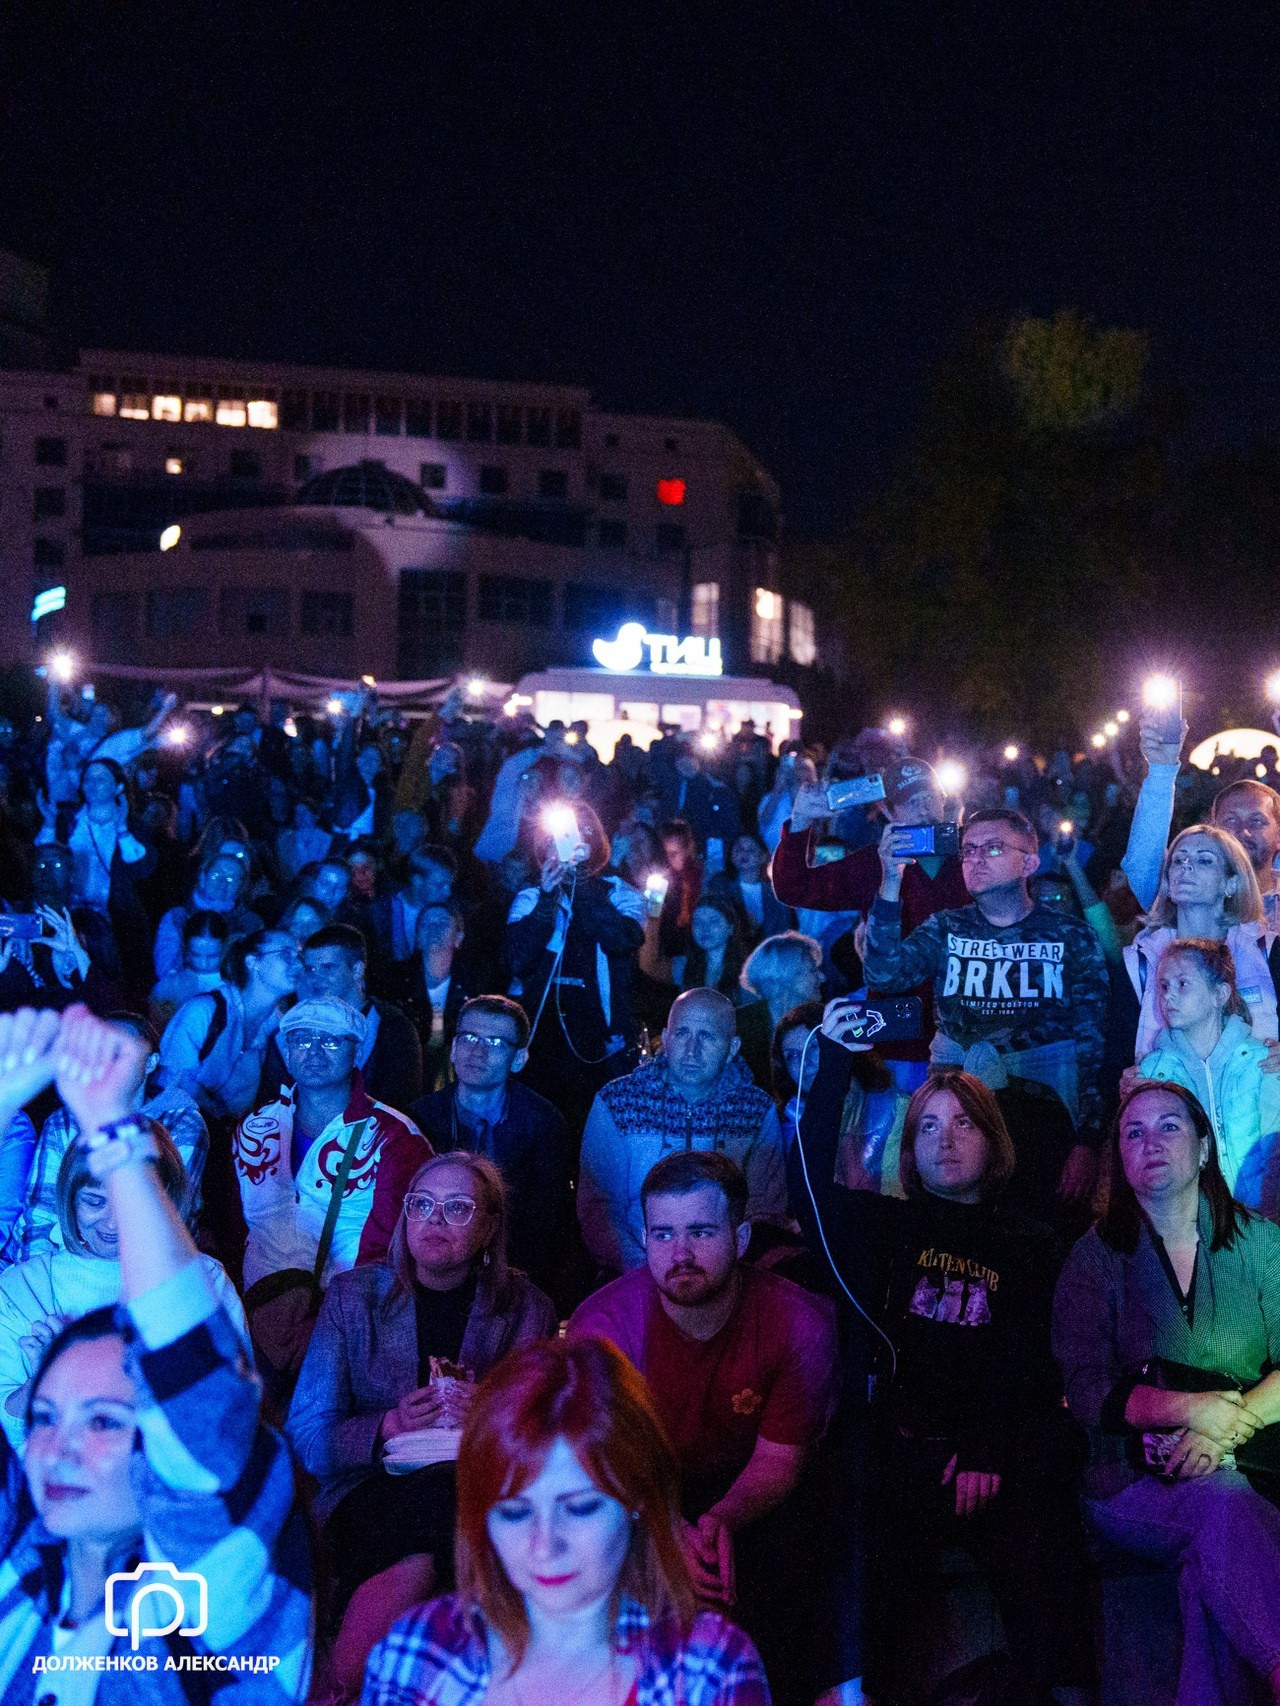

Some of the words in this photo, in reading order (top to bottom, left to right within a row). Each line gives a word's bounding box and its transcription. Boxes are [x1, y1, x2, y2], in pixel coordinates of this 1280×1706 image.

[949, 935, 1062, 961] STREETWEAR
[943, 957, 1064, 999] BRKLN
[960, 1000, 998, 1009] LIMITED
